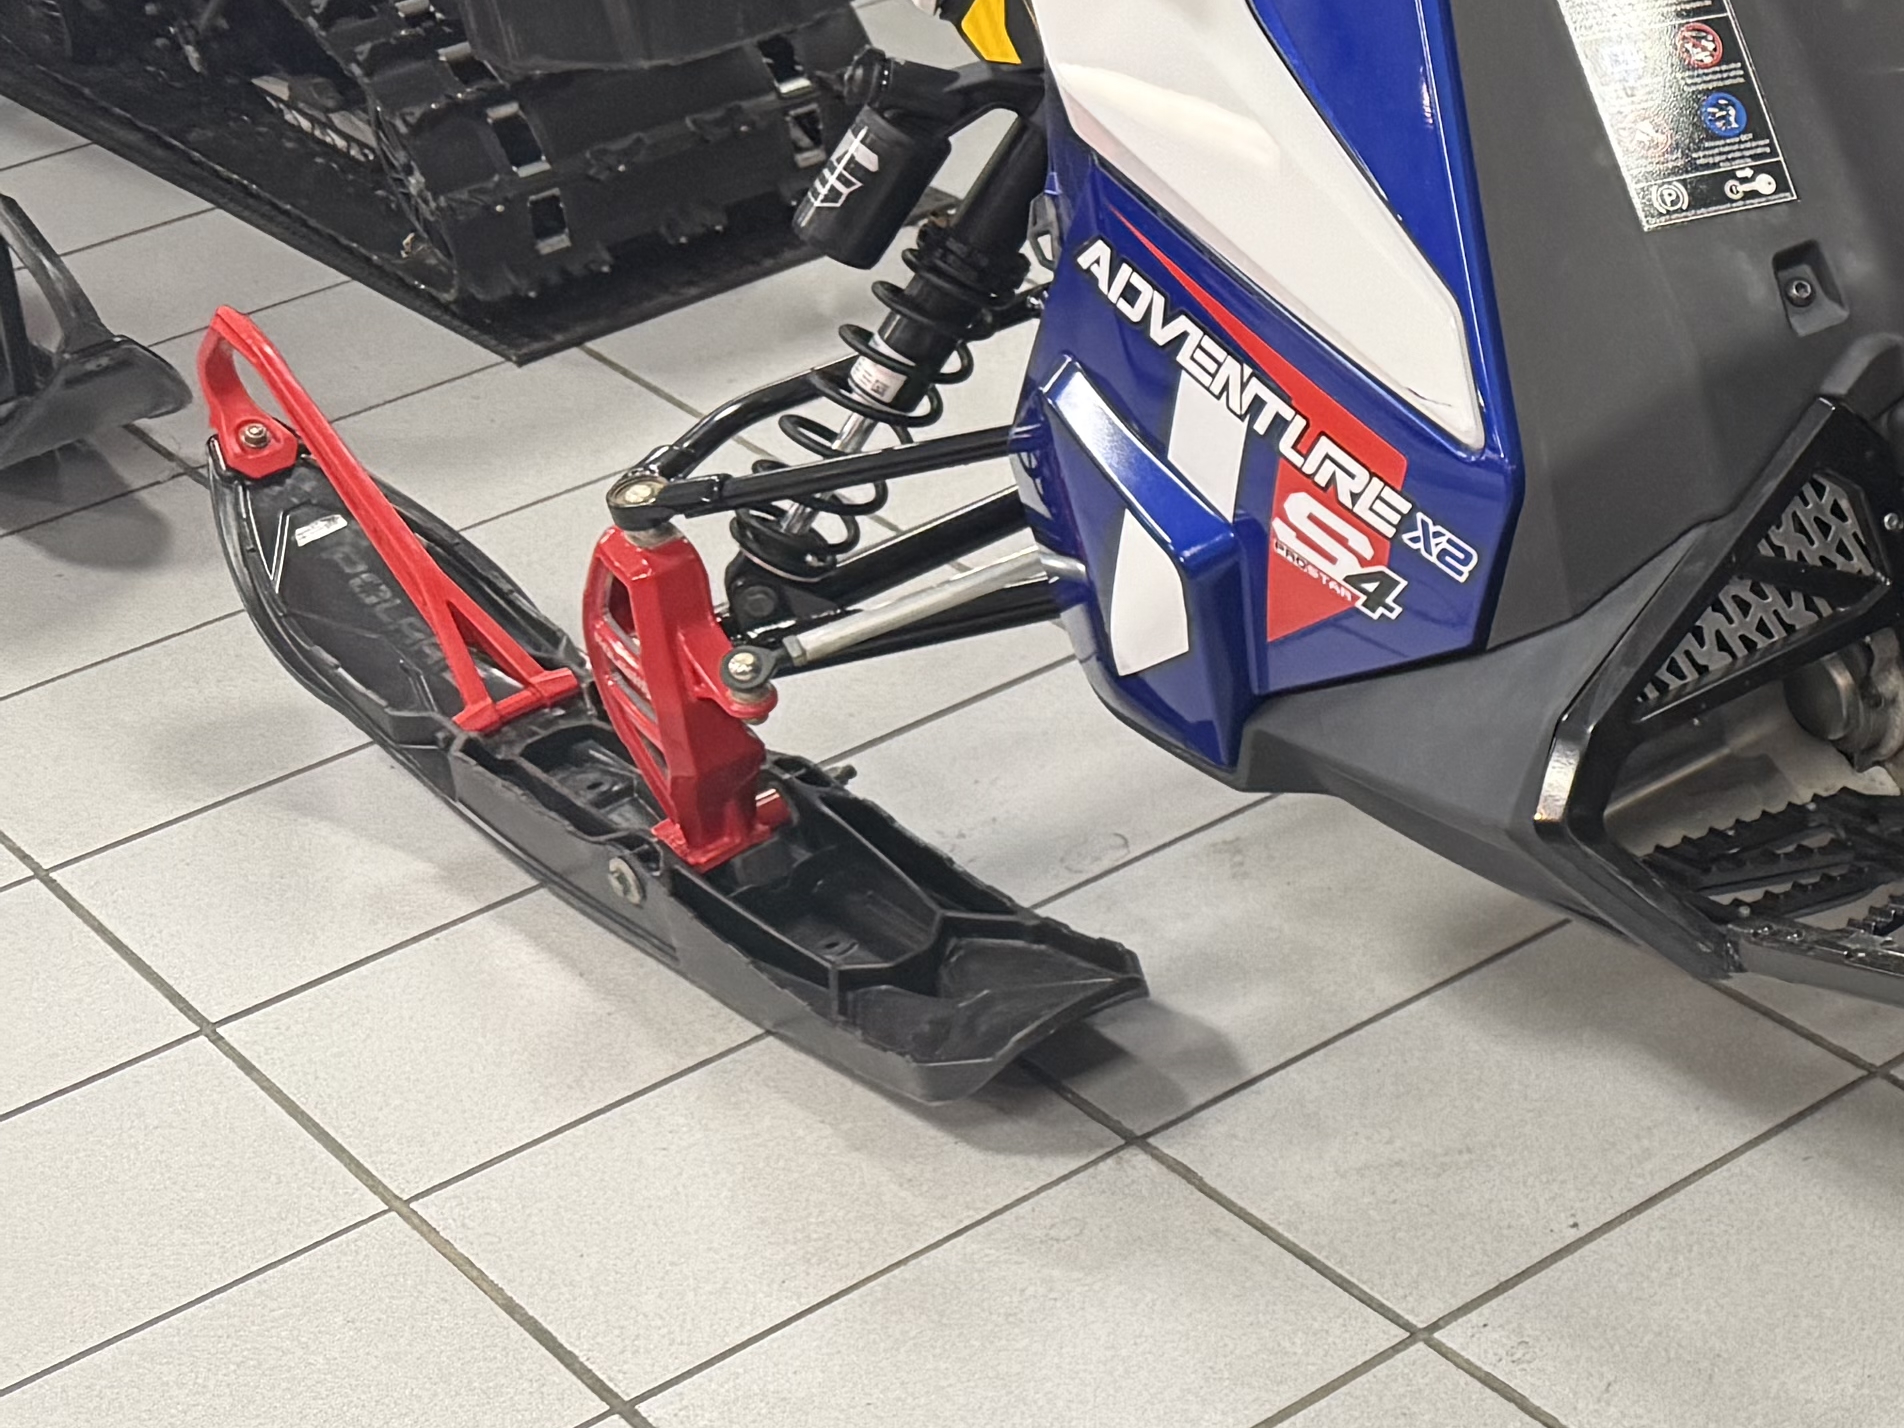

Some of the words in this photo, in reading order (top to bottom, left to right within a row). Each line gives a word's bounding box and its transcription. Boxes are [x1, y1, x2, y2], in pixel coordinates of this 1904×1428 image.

[1075, 238, 1413, 540] ADVENTURE
[1401, 510, 1480, 584] X2
[1272, 539, 1354, 603] PROSTAR
